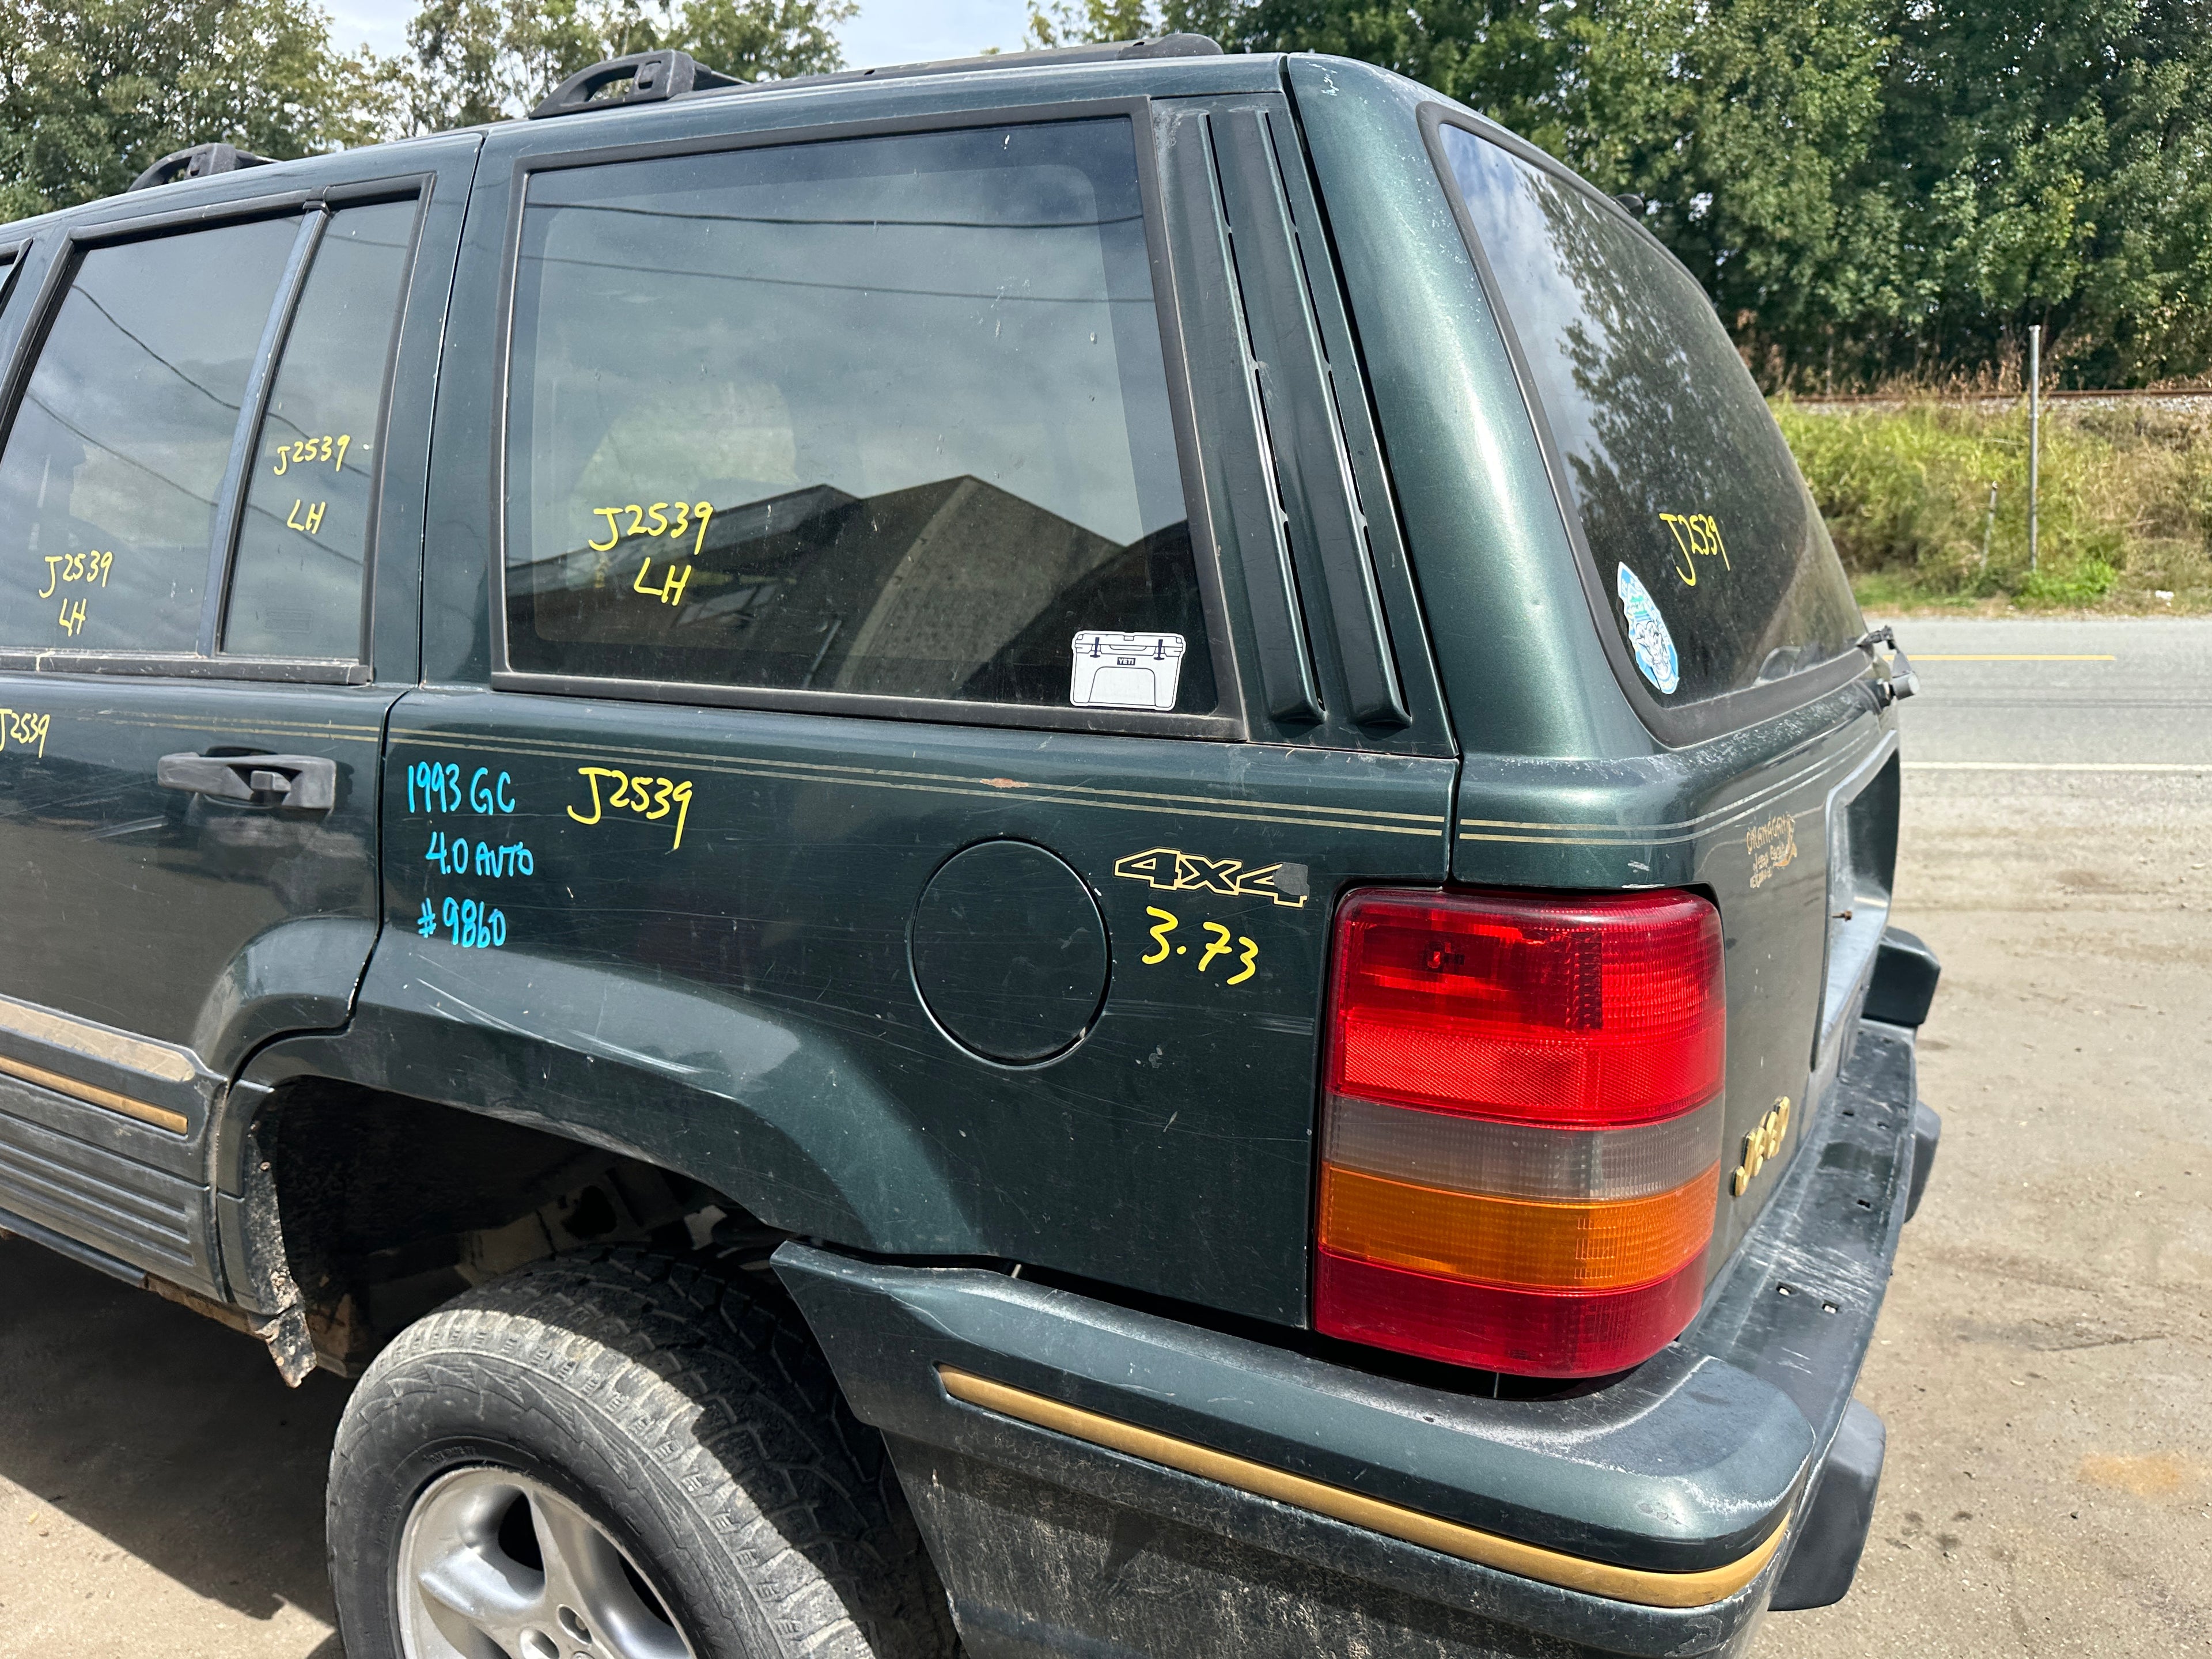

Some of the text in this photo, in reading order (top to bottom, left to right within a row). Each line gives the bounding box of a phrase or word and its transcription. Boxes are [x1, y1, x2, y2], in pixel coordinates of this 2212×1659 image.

[274, 434, 350, 475] J2539
[287, 499, 326, 533] LH
[588, 501, 714, 555] J2539
[39, 550, 113, 598] J2539
[1659, 513, 1730, 586] J2539
[634, 557, 692, 606] LH
[1118, 657, 1135, 665] YETI
[0, 708, 51, 759] J2539
[408, 761, 516, 816] 1993 GC
[567, 767, 692, 850] J2539
[425, 831, 533, 878] 4.0 AUTO
[1141, 906, 1259, 986] 3.73
